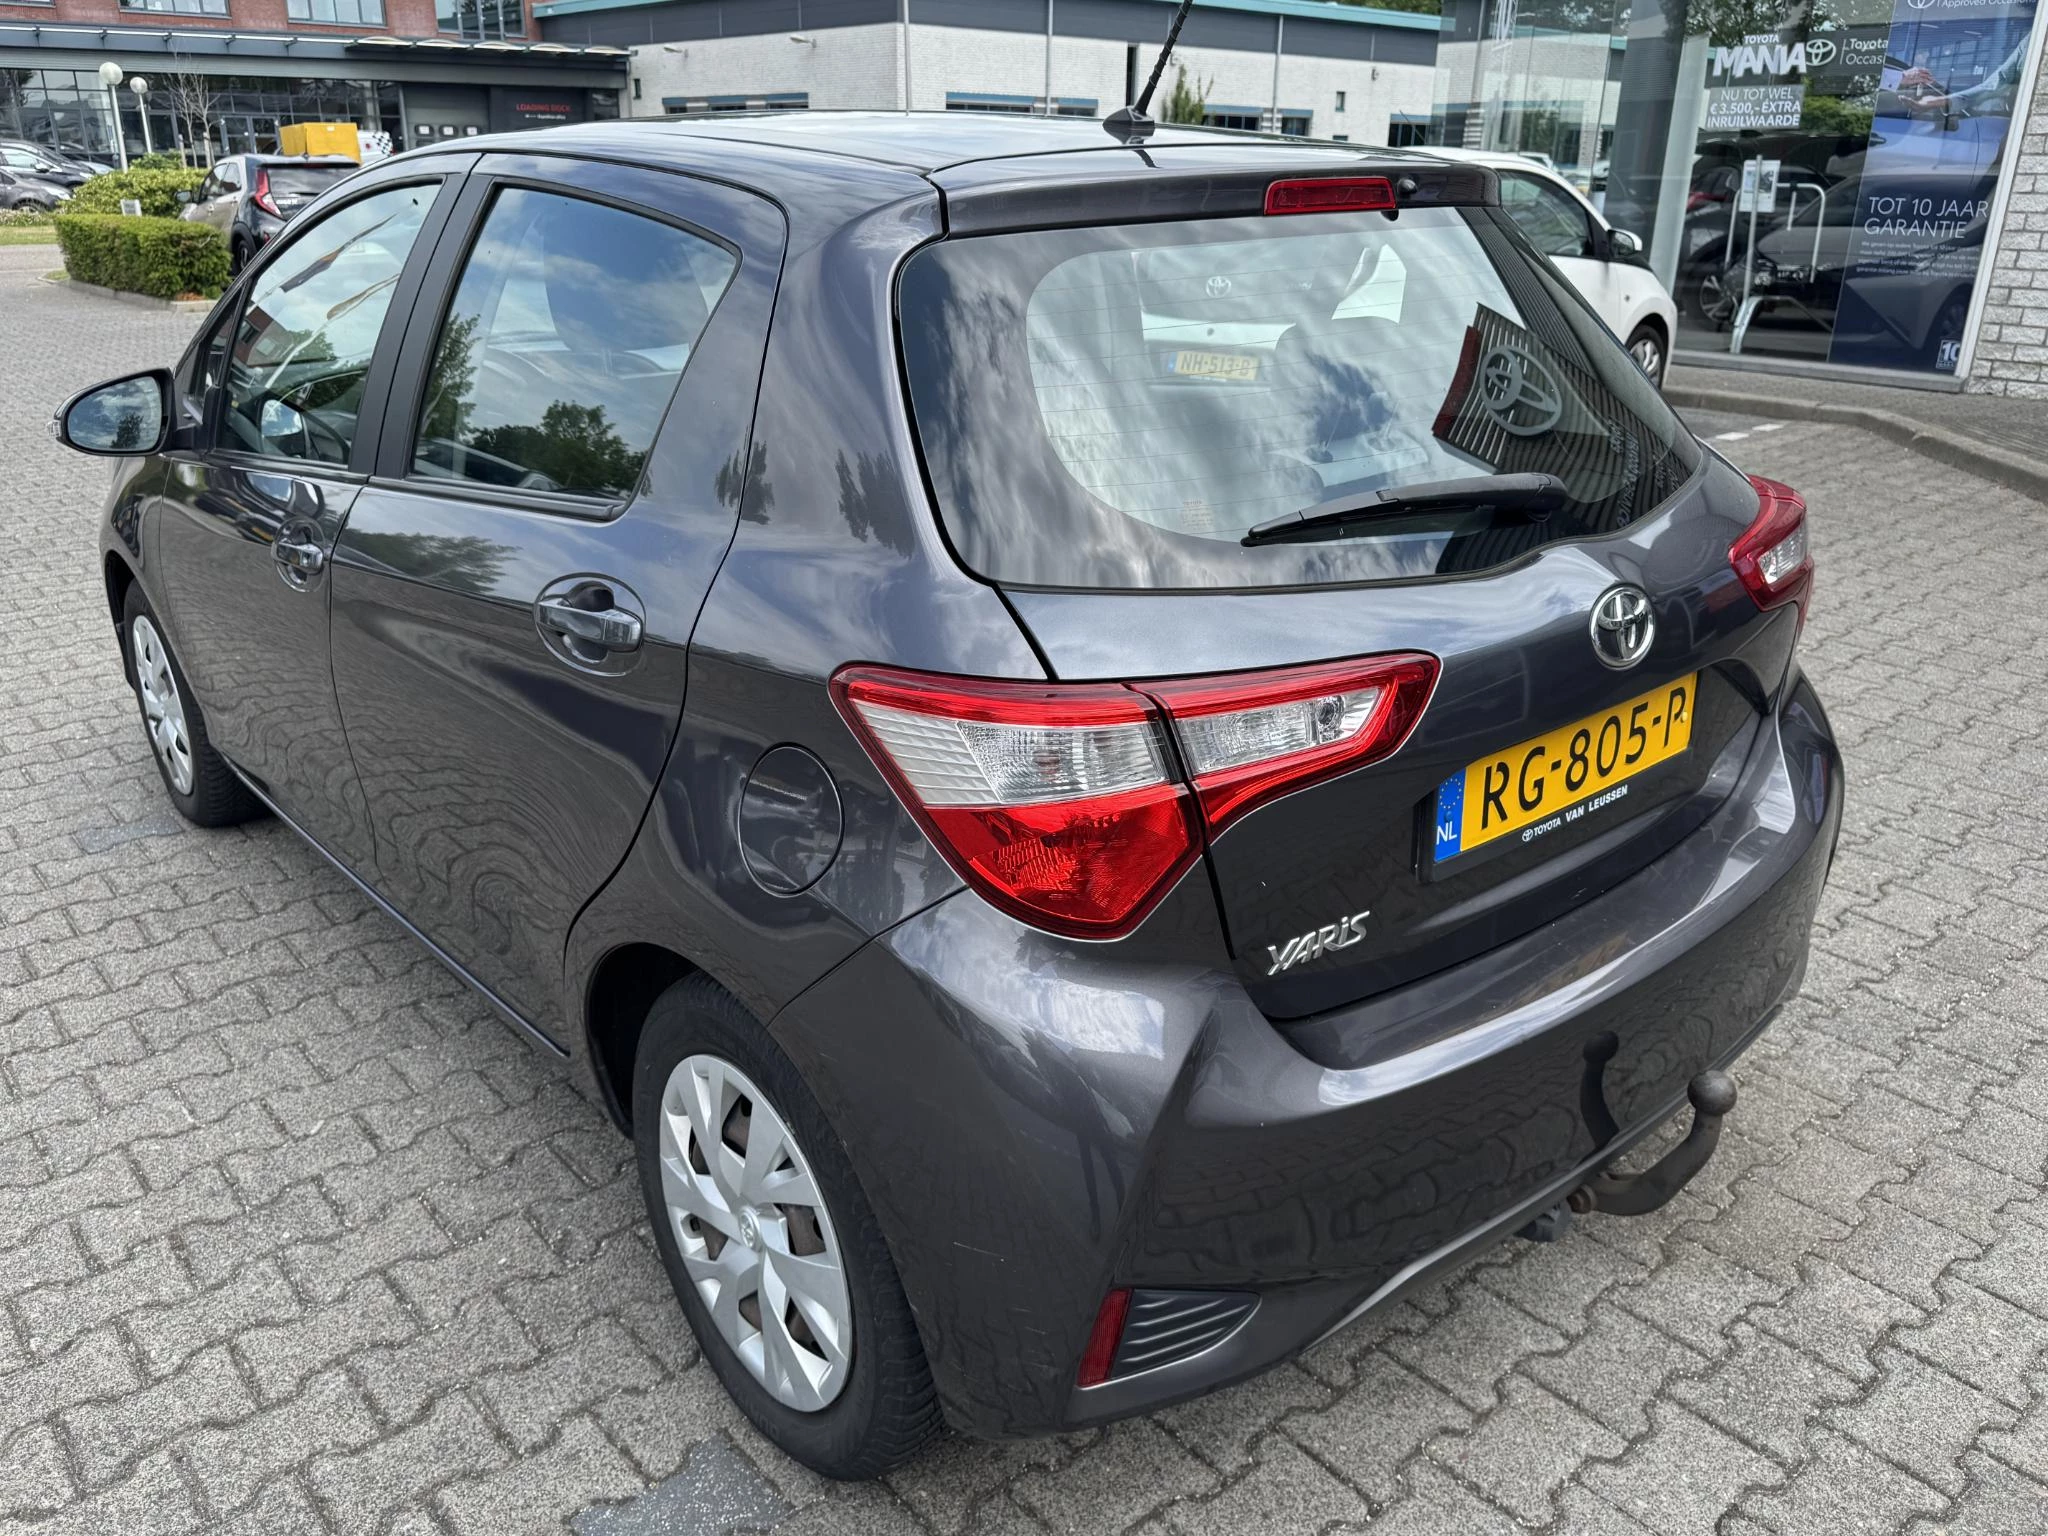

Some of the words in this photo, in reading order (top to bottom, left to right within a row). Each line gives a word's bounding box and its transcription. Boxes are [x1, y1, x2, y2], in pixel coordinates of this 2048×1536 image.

[1744, 34, 1780, 45] TOYOTA
[1849, 38, 1889, 52] Toyota
[1712, 42, 1807, 79] MANIA
[1720, 88, 1738, 101] NU
[1743, 89, 1766, 101] TOT
[1768, 87, 1794, 100] WEL
[1710, 104, 1718, 114] €
[1719, 102, 1760, 115] 3.500,-
[1762, 101, 1801, 113] EXTRA
[1707, 114, 1800, 128] INRUILWAARDE
[1869, 196, 1906, 215] TOT
[1912, 198, 1932, 216] 10
[1936, 199, 1989, 218] JAAR
[1864, 217, 1968, 239] GARANTIE
[1480, 686, 1687, 831] RG-805-P
[1532, 816, 1562, 837] TOYOTA
[1565, 804, 1585, 822] VAN
[1588, 783, 1628, 813] LEUSSEN
[1436, 820, 1458, 846] NL
